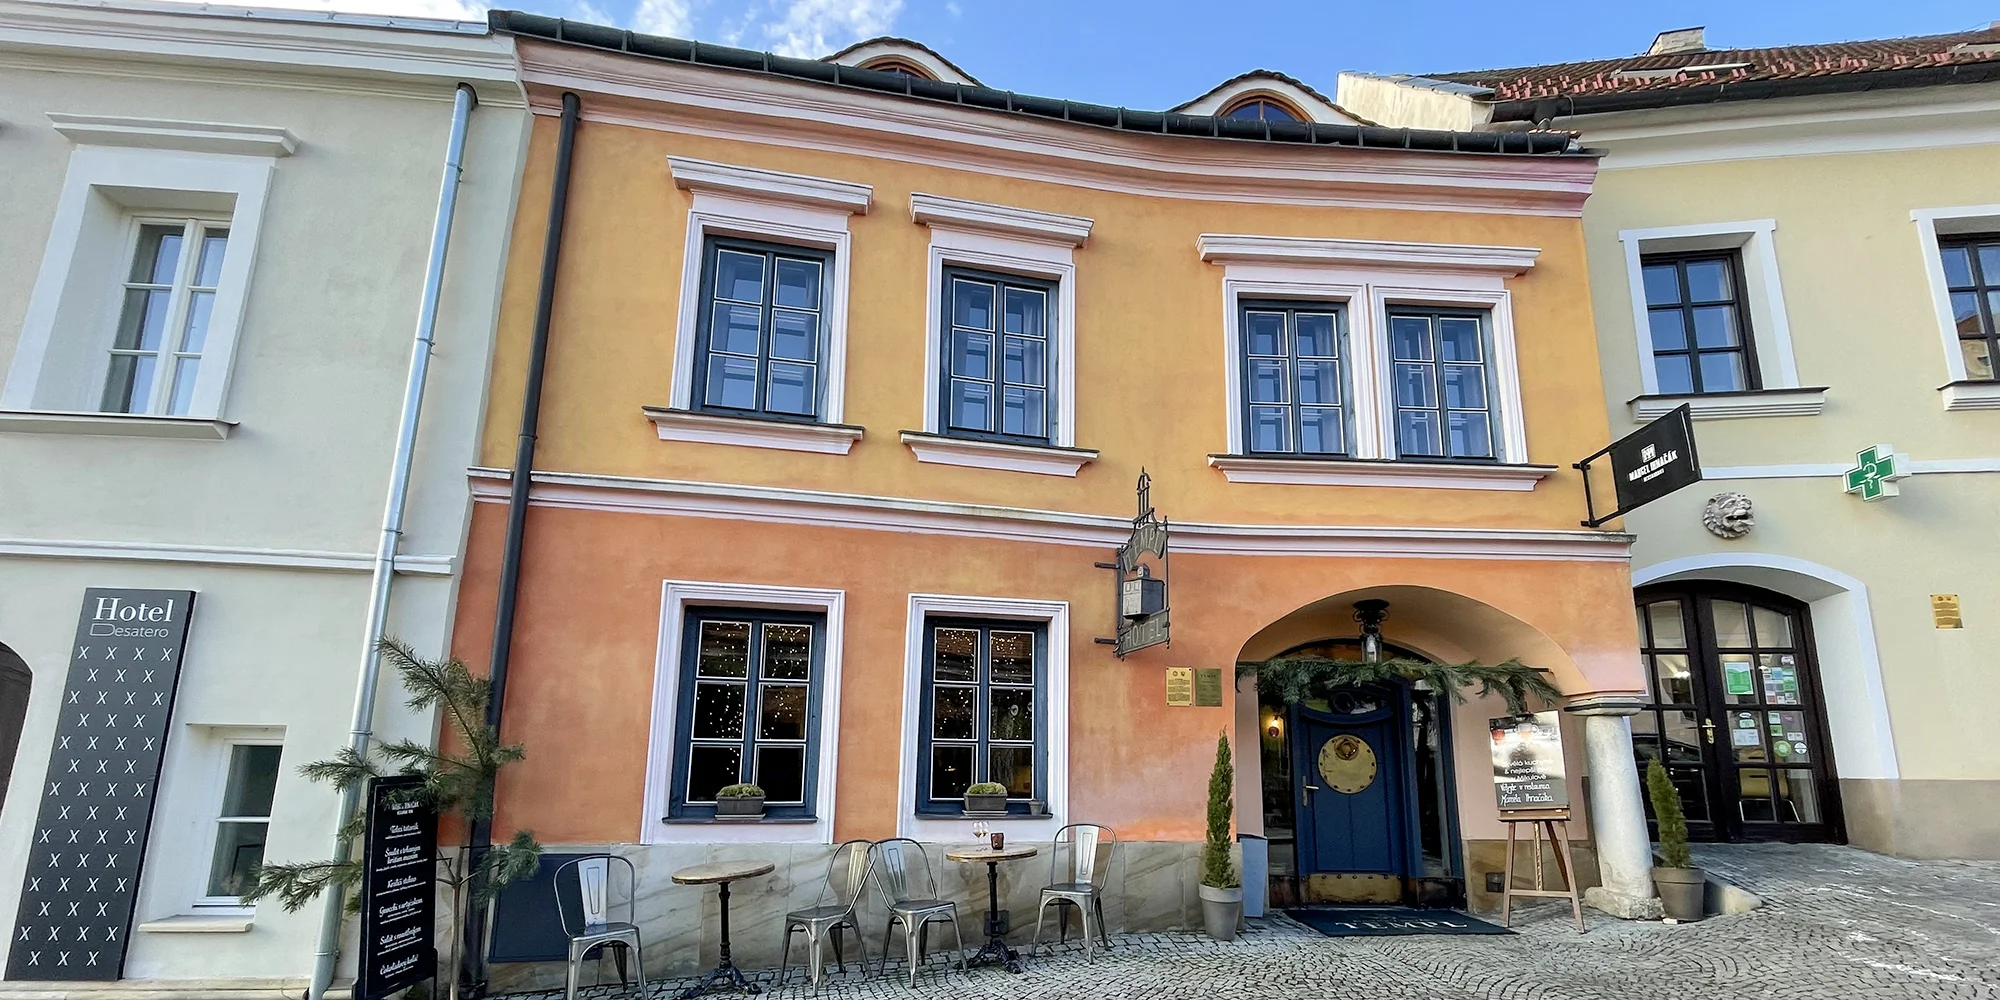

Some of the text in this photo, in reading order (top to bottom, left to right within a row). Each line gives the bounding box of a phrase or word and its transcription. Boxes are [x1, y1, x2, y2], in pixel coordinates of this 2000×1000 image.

[93, 597, 174, 622] Hotel
[90, 623, 169, 638] Desatero
[1124, 617, 1162, 649] HOTEL
